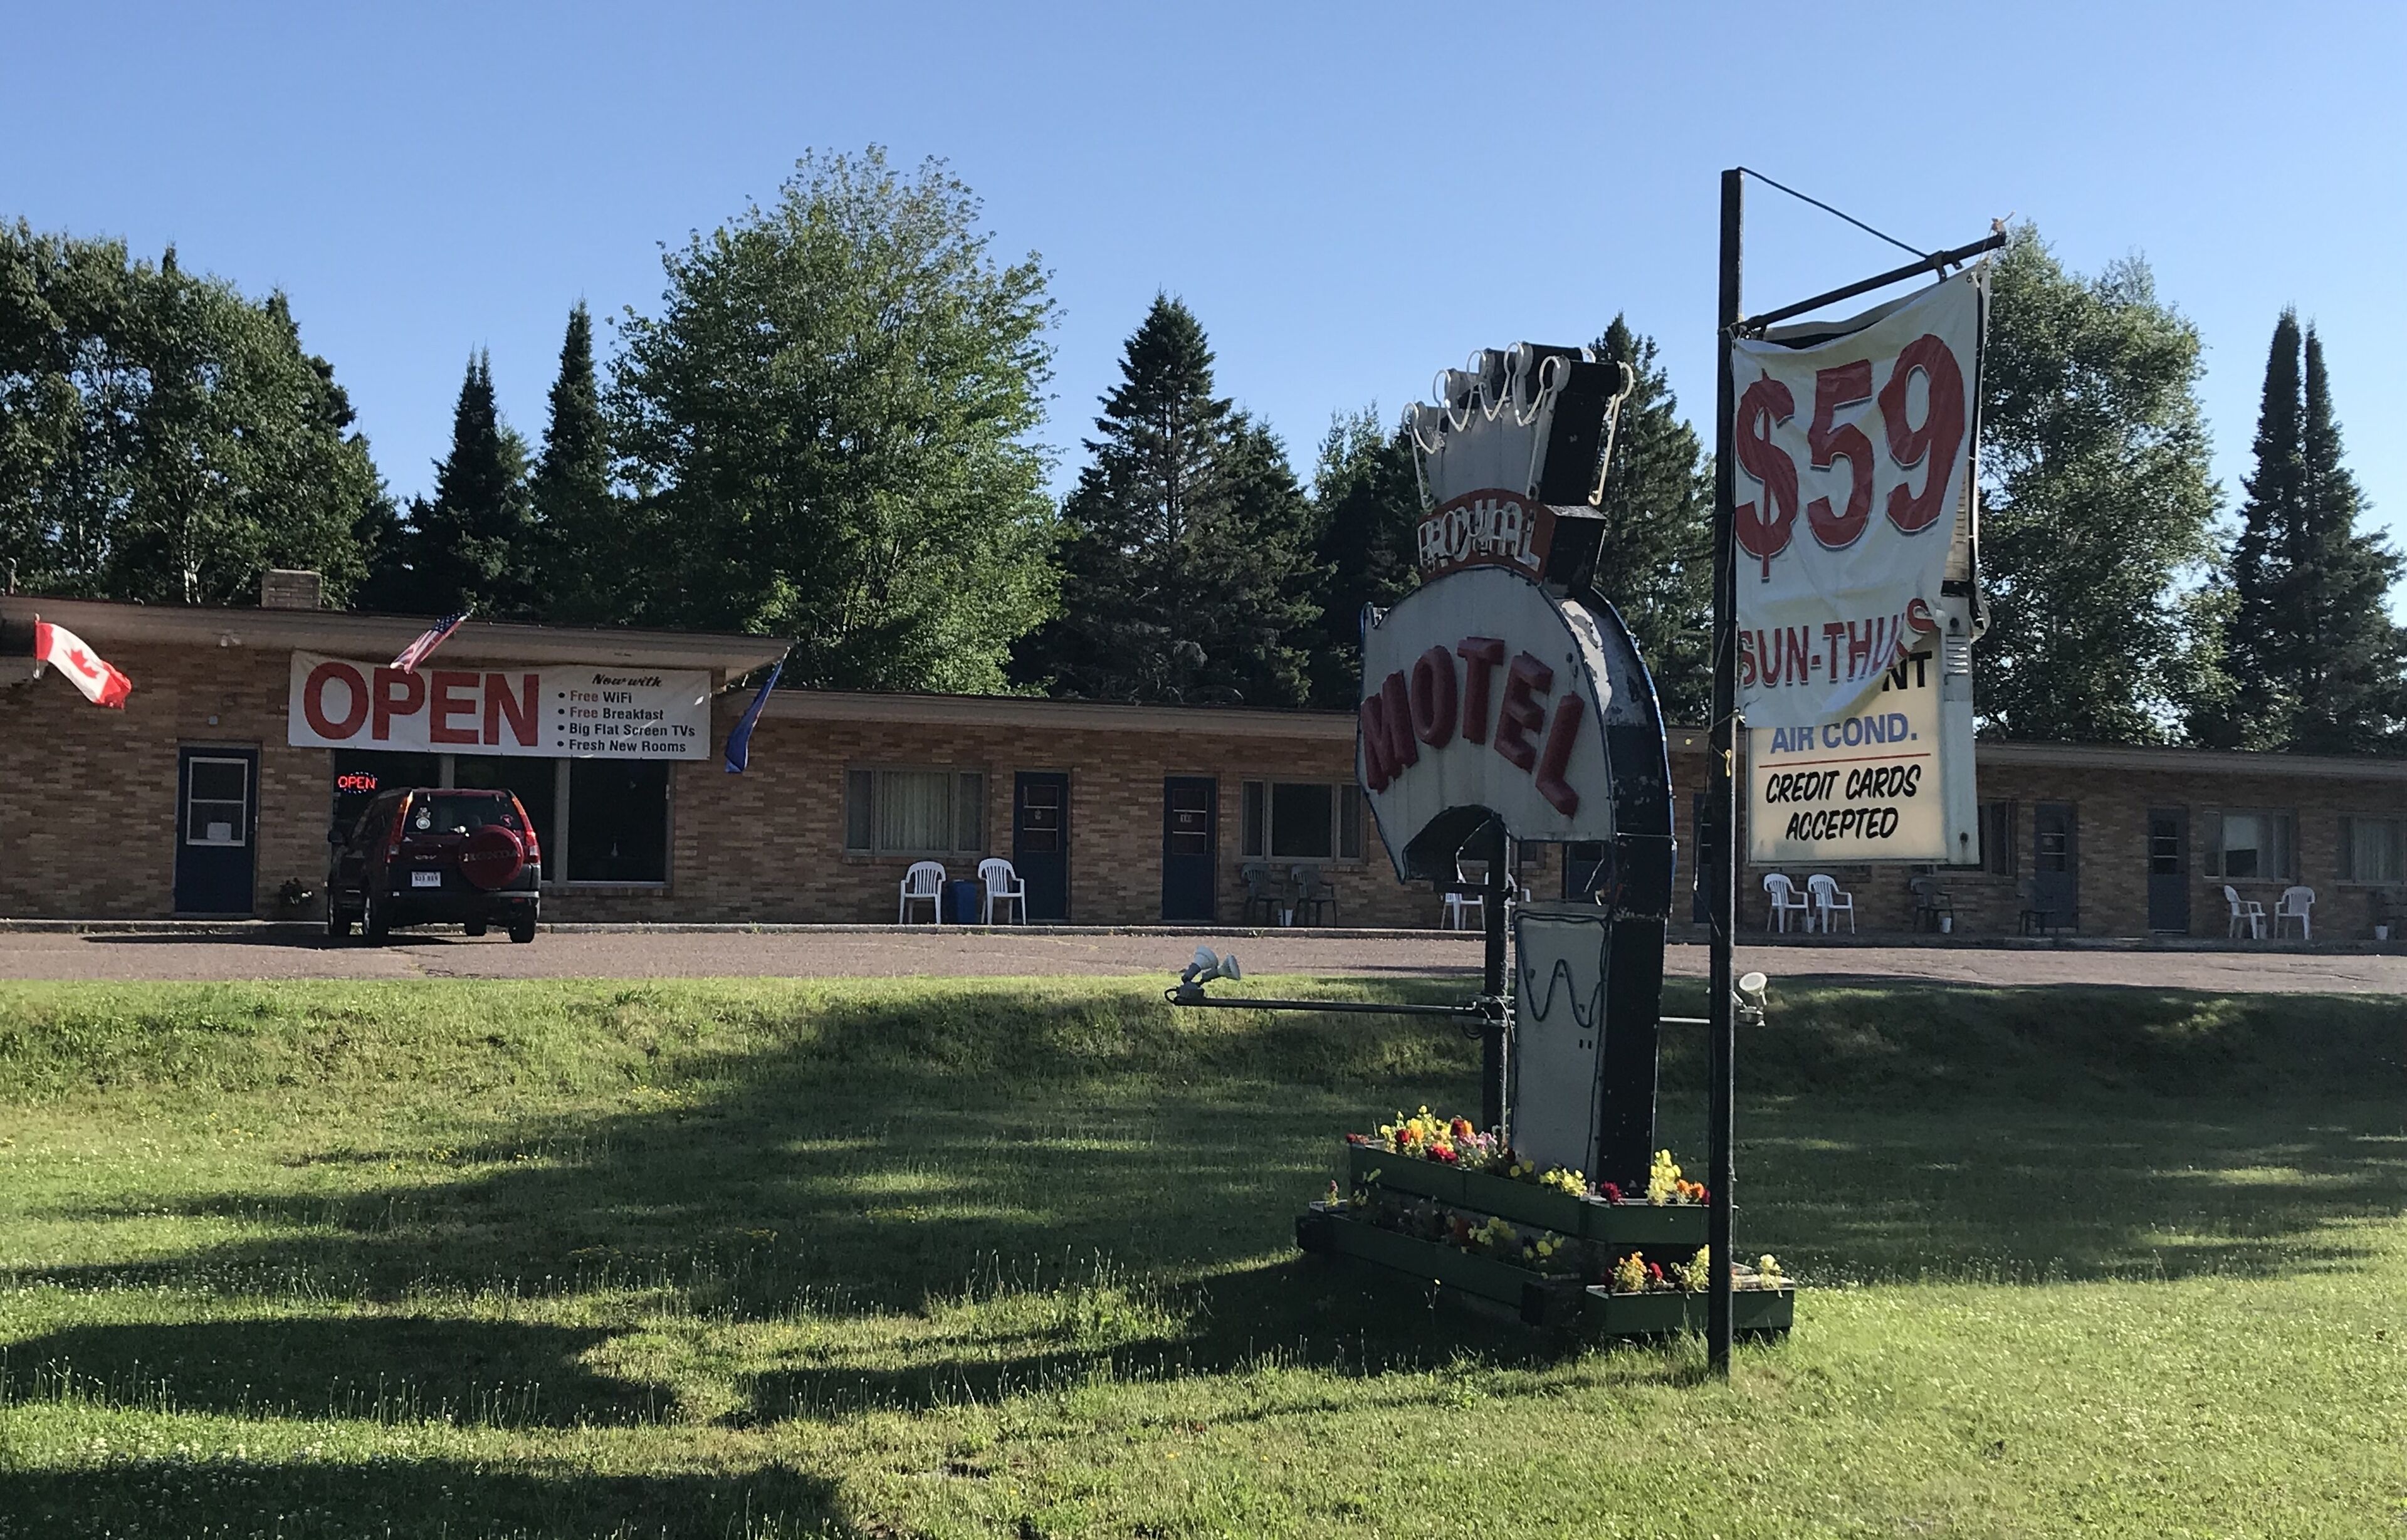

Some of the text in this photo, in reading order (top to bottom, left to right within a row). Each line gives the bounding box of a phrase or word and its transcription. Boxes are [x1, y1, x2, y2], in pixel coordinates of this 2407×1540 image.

[1734, 332, 1966, 582] $59
[1417, 498, 1541, 574] ROYAL
[570, 690, 632, 703] Free WiFi
[592, 673, 663, 687] Now with
[303, 661, 538, 746] OPEN
[570, 706, 664, 720] Free Breakfast
[569, 723, 695, 736] Big Flat Screen TVs
[1360, 636, 1586, 820] MOTEL
[1770, 713, 1917, 754] AIR COND.
[569, 739, 686, 752] Fresh New Rooms
[338, 776, 375, 789] OPEN
[1766, 764, 1921, 804] CREDIT CARDS
[1786, 807, 1899, 841] ACCEPTED
